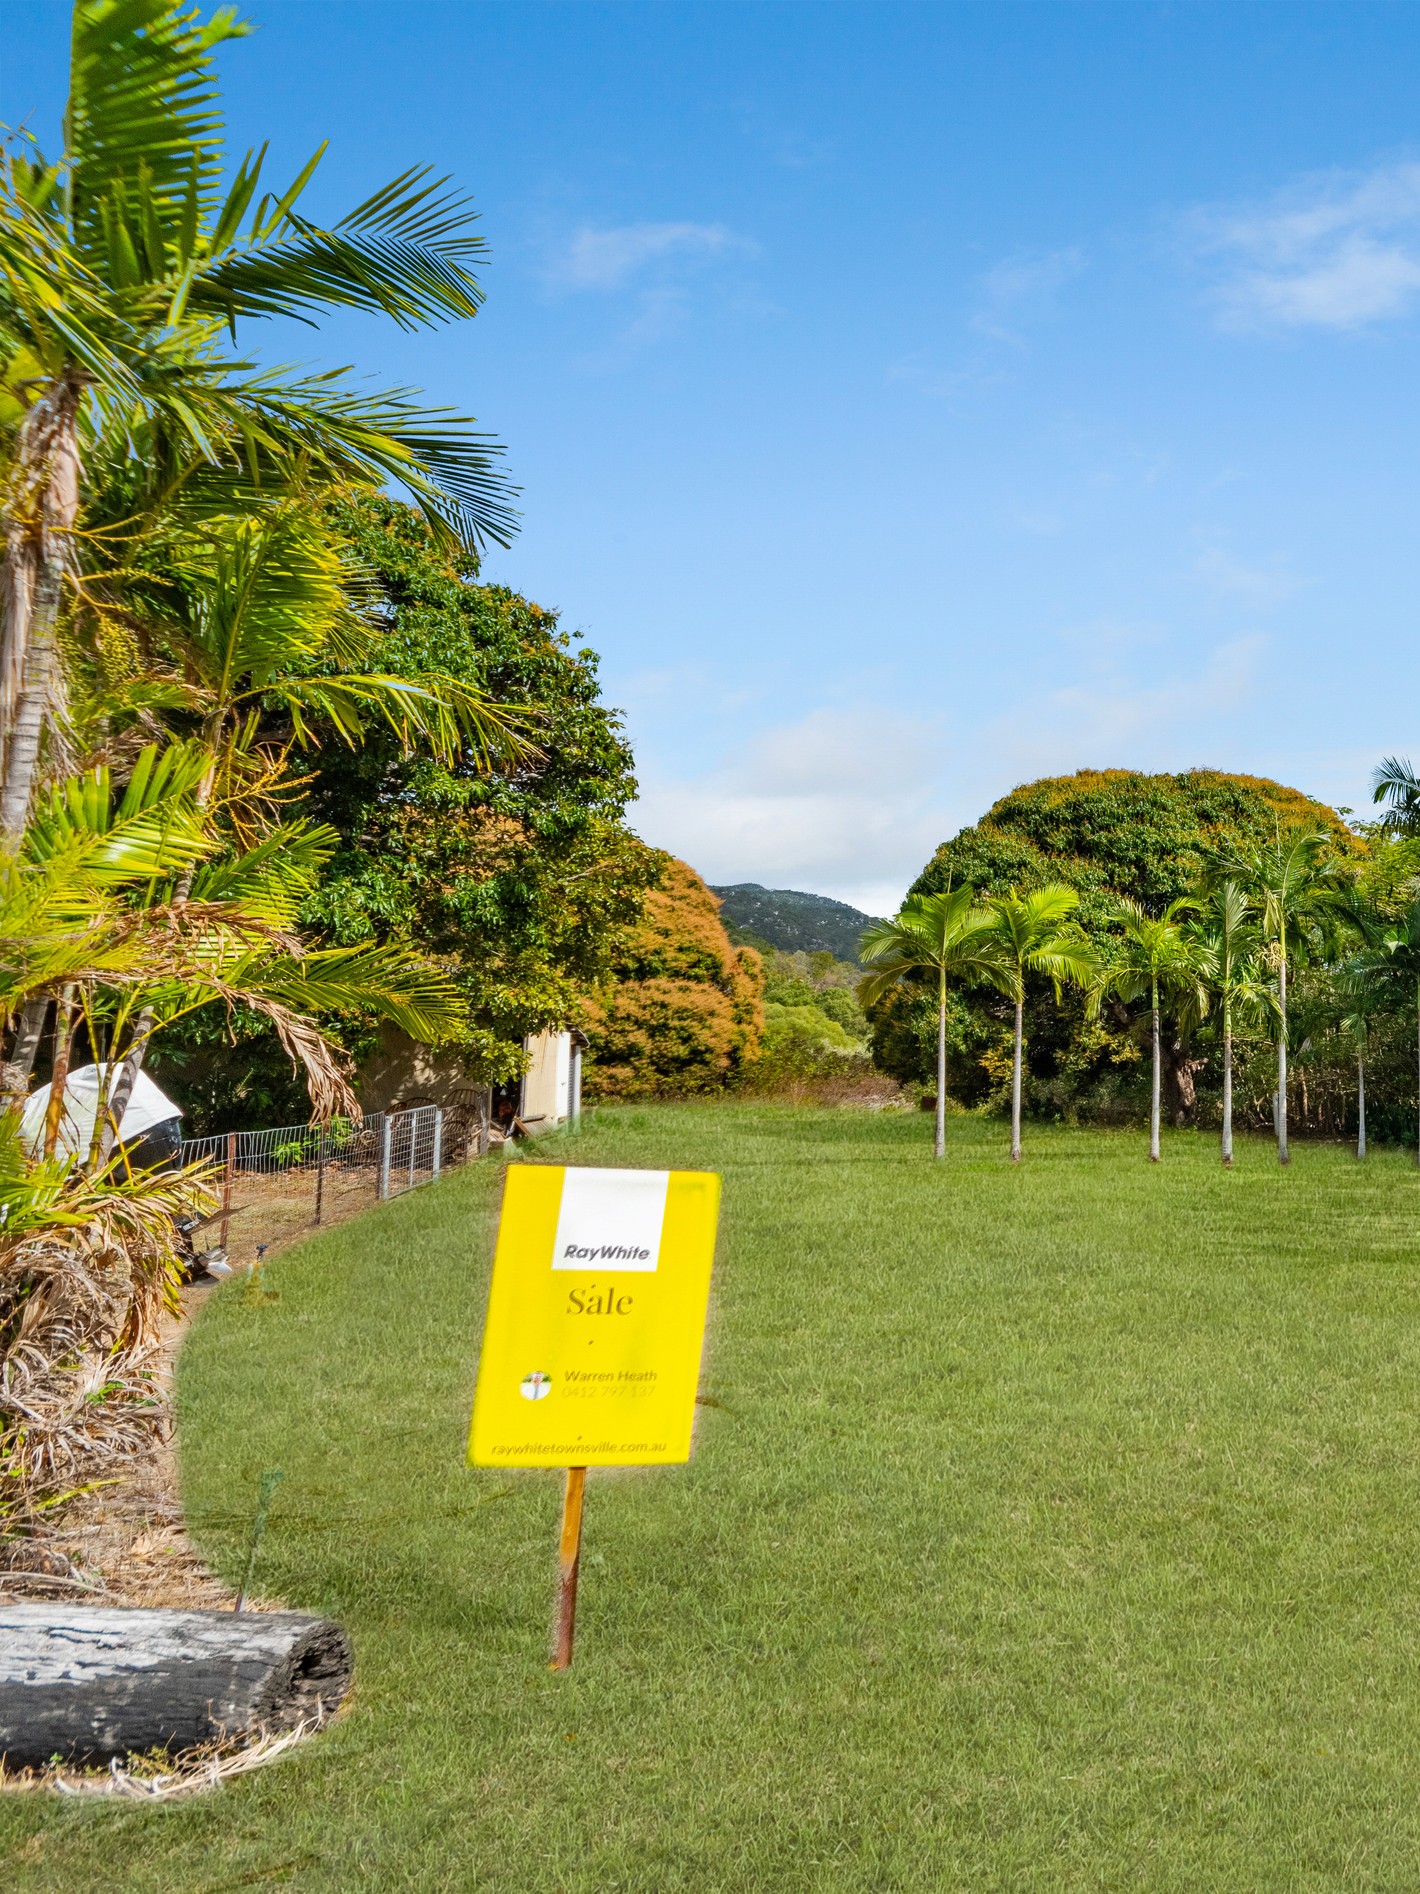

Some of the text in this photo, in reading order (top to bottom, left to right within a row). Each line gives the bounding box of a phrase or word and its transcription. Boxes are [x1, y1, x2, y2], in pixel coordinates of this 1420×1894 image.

[564, 1244, 650, 1261] RayWhite
[566, 1287, 633, 1315] Sale
[564, 1370, 657, 1383] Warren Heath
[561, 1386, 599, 1399] 0412
[491, 1441, 667, 1456] raywhitetownsville.com.au
